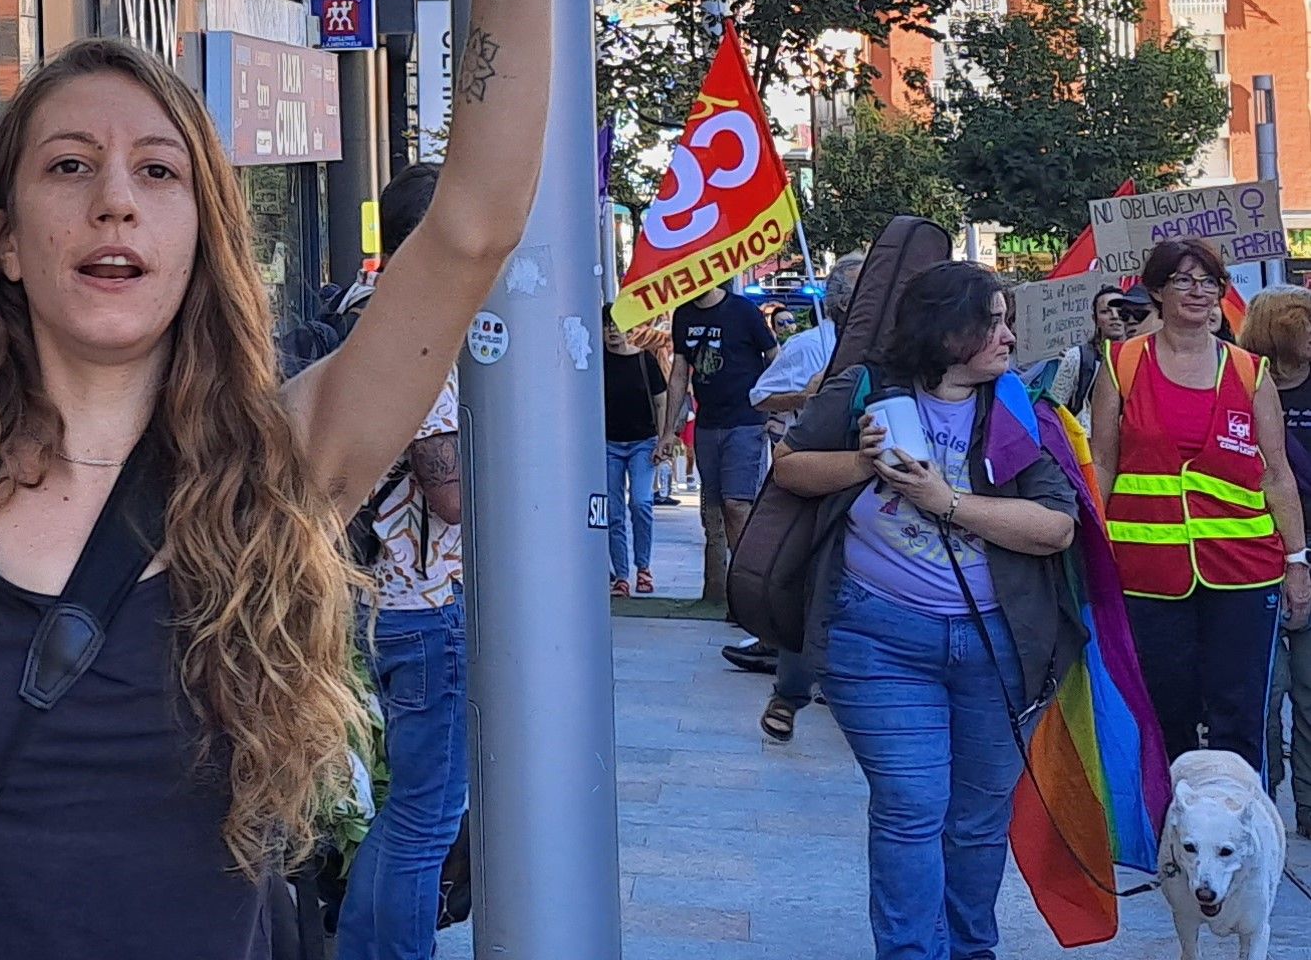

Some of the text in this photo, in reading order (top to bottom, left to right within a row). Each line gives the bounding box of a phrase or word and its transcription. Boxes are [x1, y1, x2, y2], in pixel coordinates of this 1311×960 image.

[276, 99, 309, 157] CUINA
[1093, 190, 1233, 226] NO OBLIGUEM A
[1151, 208, 1238, 241] ABORTAR
[1221, 244, 1230, 258] A
